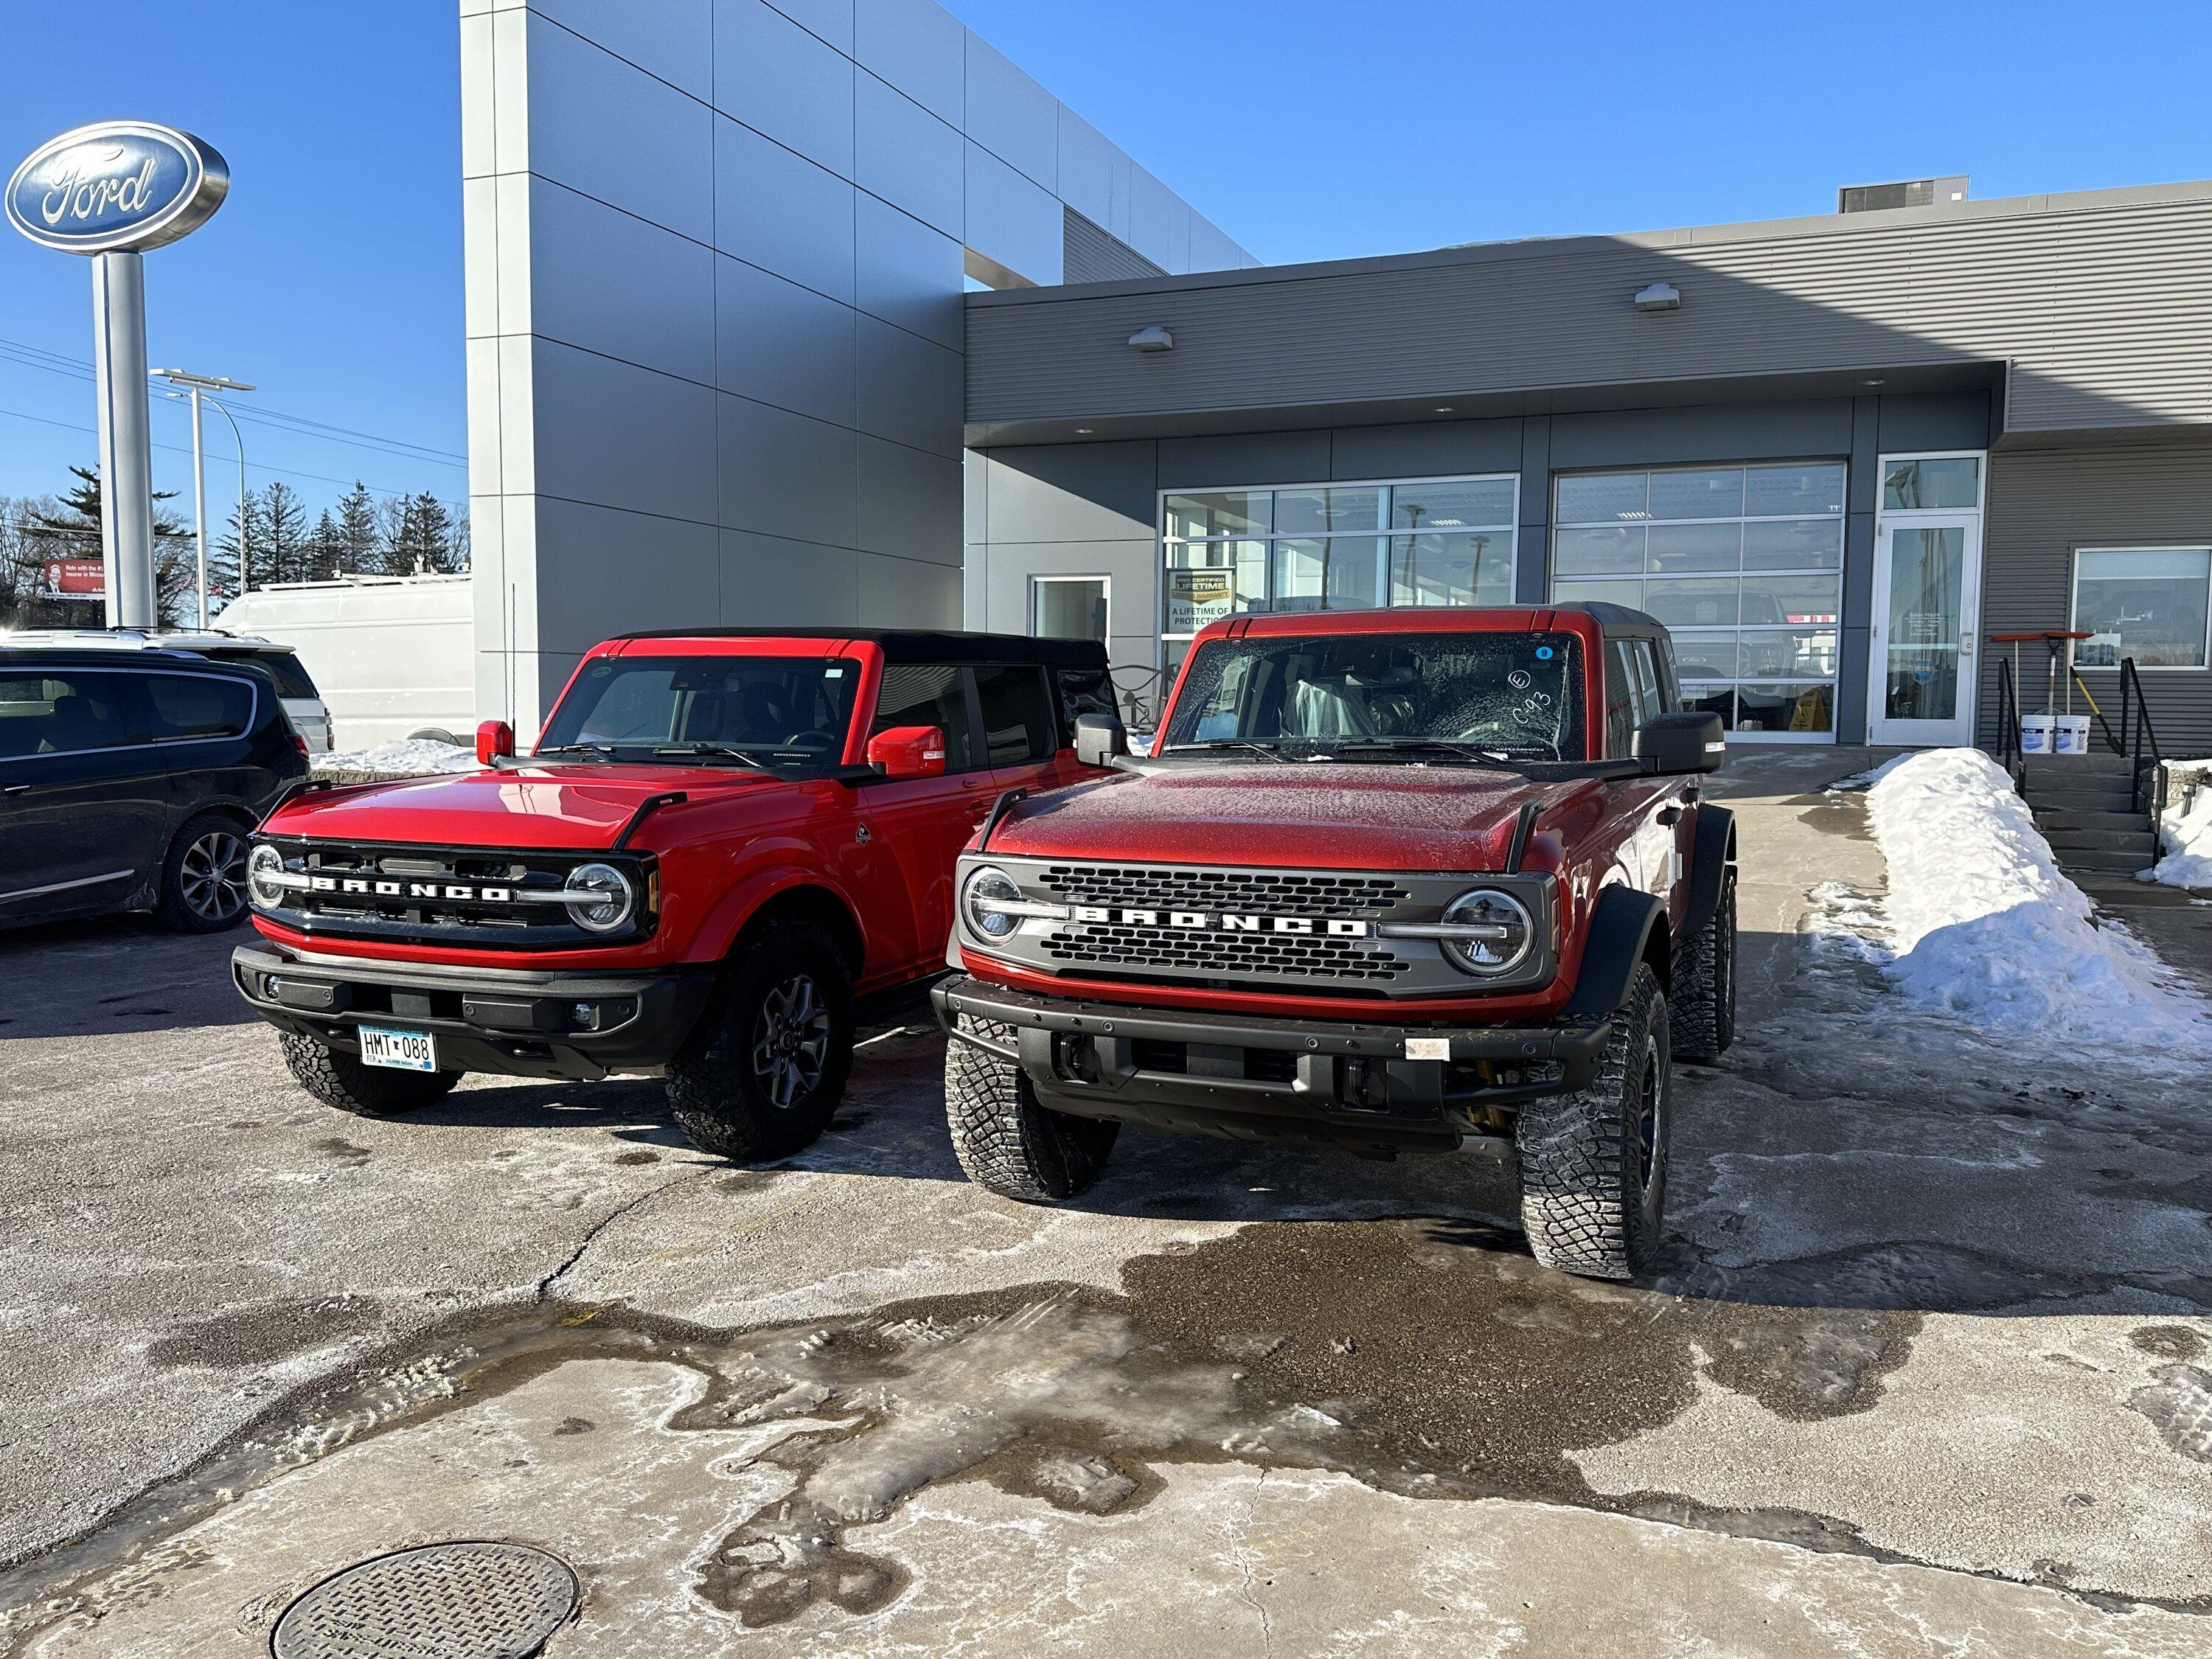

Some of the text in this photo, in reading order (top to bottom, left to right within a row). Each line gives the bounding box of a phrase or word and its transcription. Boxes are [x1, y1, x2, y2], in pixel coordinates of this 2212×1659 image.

[42, 147, 154, 226] Ford
[312, 877, 510, 901] BRONCO
[1075, 906, 1367, 936] BRONCO
[364, 1033, 429, 1060] HMT 088
